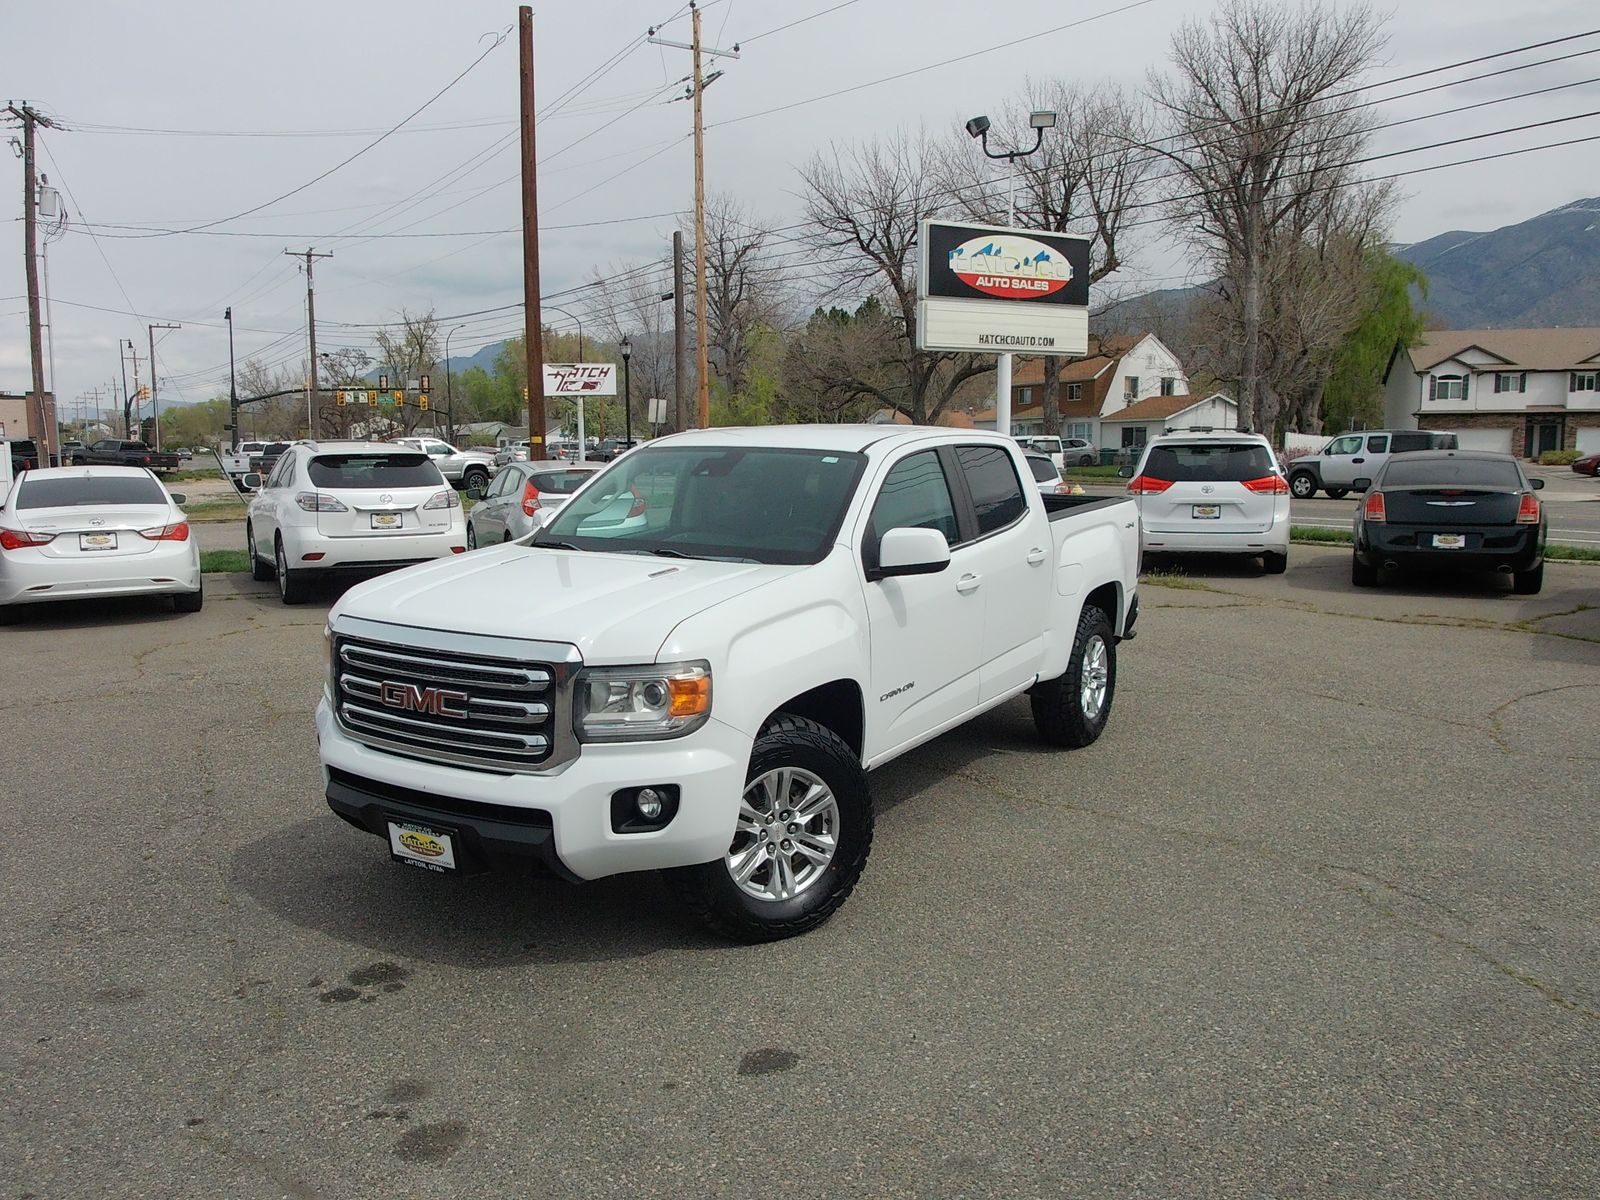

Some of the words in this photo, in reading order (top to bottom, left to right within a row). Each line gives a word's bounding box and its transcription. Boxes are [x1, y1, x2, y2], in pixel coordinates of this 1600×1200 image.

[975, 276, 1010, 288] AUTO
[1011, 278, 1049, 291] SALES
[978, 334, 1055, 347] HATCHCOAUTO.COM
[381, 680, 468, 719] GMC
